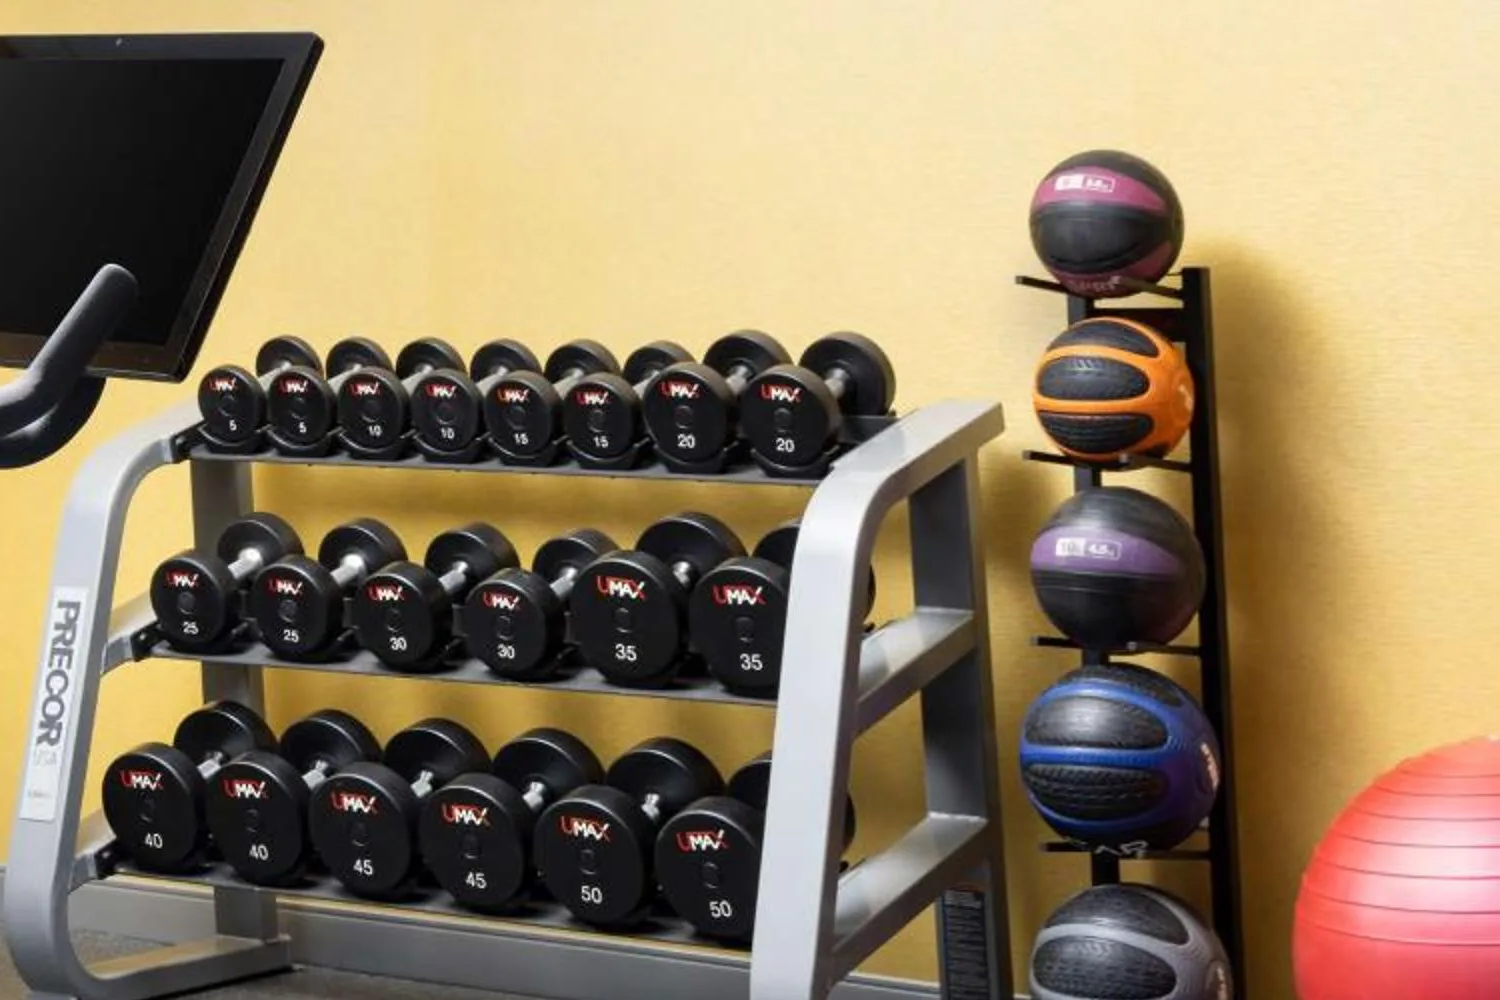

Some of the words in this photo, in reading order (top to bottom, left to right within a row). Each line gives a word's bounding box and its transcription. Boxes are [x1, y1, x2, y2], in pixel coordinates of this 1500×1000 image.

[229, 419, 237, 431] 5
[298, 421, 307, 434] 5
[593, 435, 609, 449] 15
[677, 433, 696, 449] 20
[775, 437, 795, 453] 20
[182, 621, 199, 635] 25
[283, 628, 300, 643] 25
[389, 636, 408, 651] 30
[497, 643, 516, 660] 30
[615, 643, 637, 662] 35
[739, 653, 764, 671] 35
[35, 599, 81, 747] PRECOR
[144, 832, 163, 849] 40
[249, 844, 269, 861] 40
[353, 858, 374, 876] 45
[465, 871, 487, 889] 45
[581, 885, 603, 904] 50
[709, 899, 733, 918] 50
